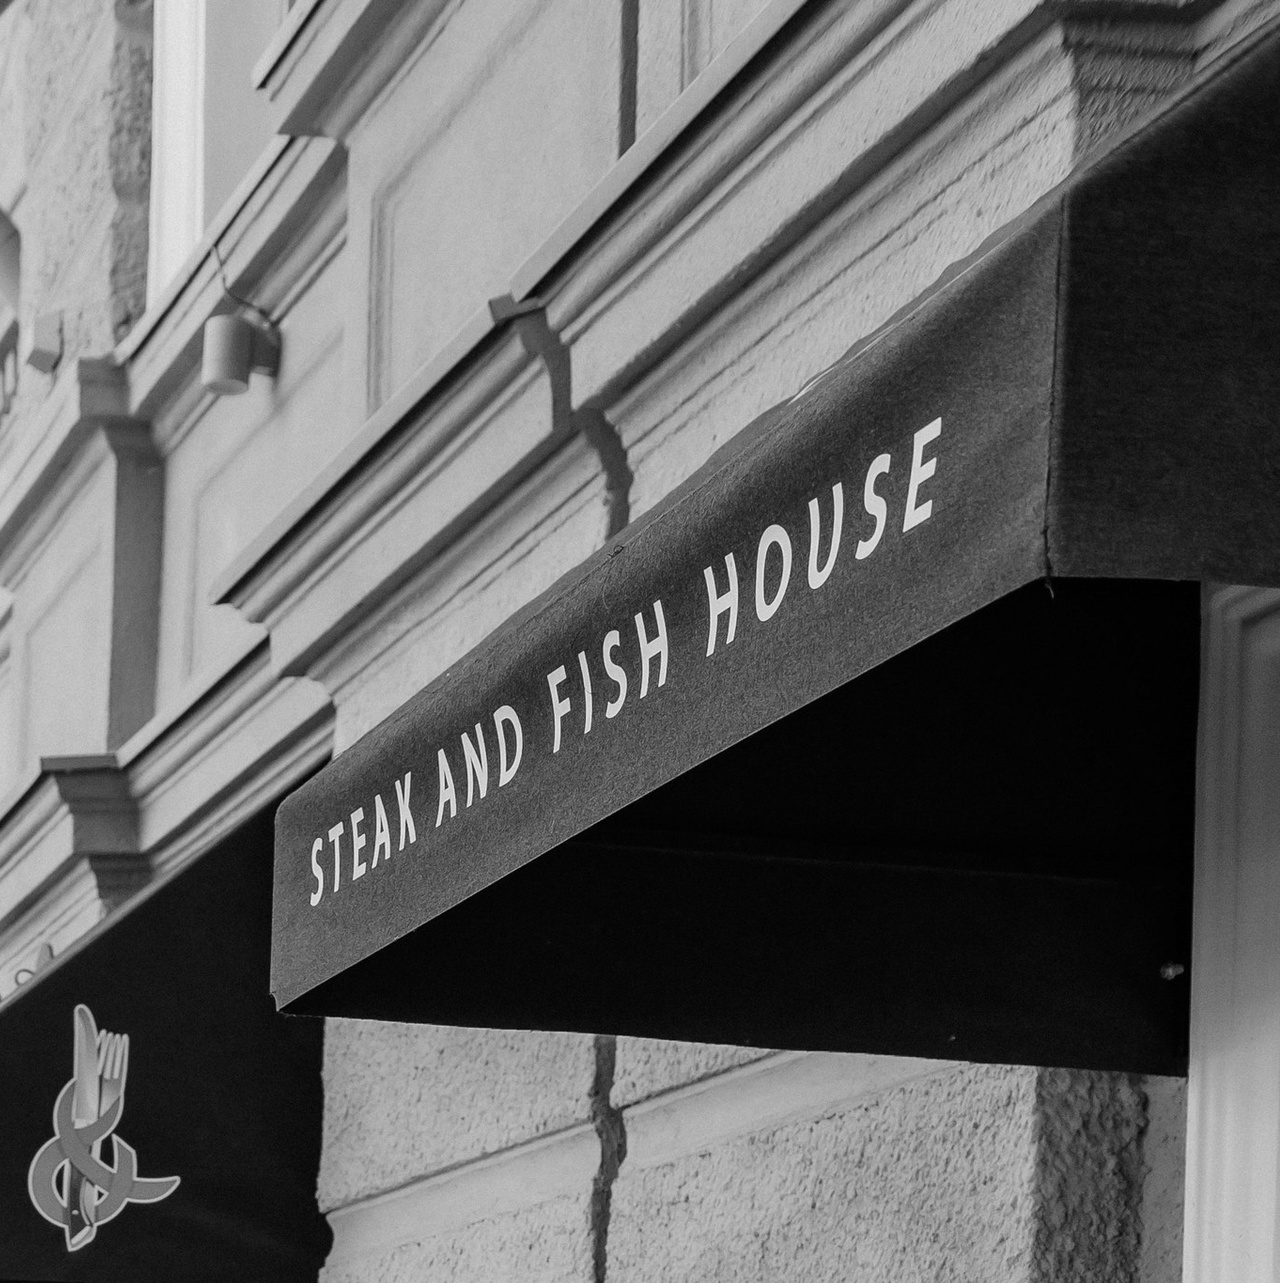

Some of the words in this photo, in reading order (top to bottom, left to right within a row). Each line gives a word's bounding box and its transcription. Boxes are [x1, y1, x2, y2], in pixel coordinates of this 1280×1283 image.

[310, 772, 417, 906] STEAK
[435, 705, 524, 827] AND
[546, 600, 669, 753] FISH
[703, 417, 942, 657] HOUSE
